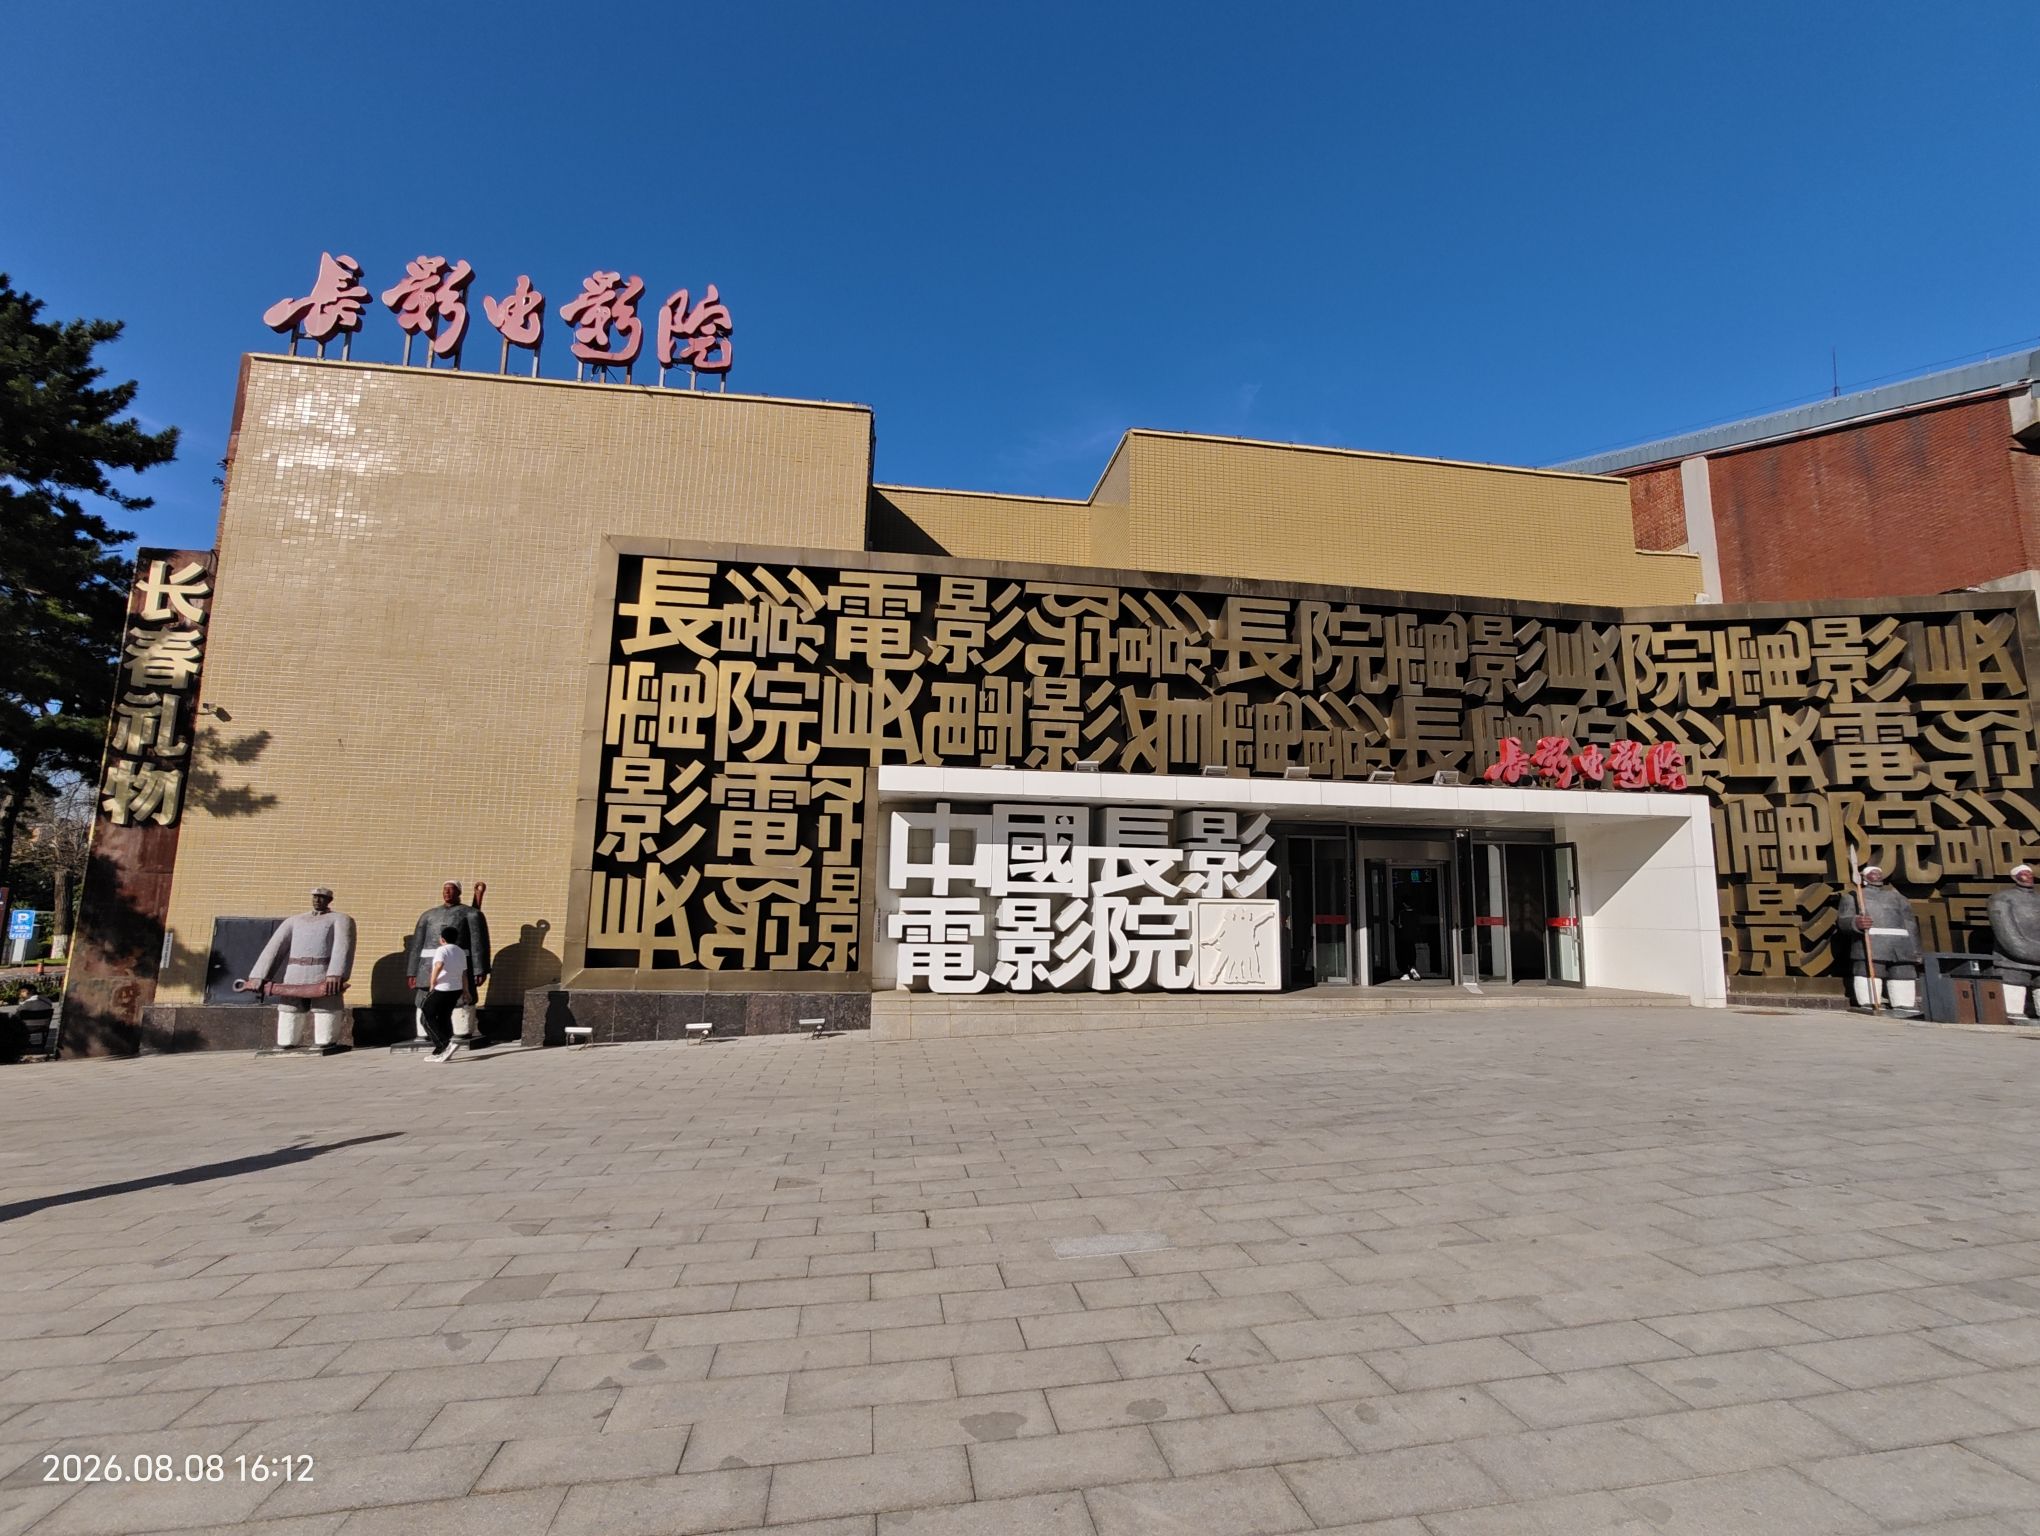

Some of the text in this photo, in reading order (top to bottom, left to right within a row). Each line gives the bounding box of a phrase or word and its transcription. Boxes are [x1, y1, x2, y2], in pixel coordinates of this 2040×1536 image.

[101, 560, 212, 826] 长春礼物
[888, 802, 1278, 899] 中國長影
[887, 896, 1196, 994] 電影院
